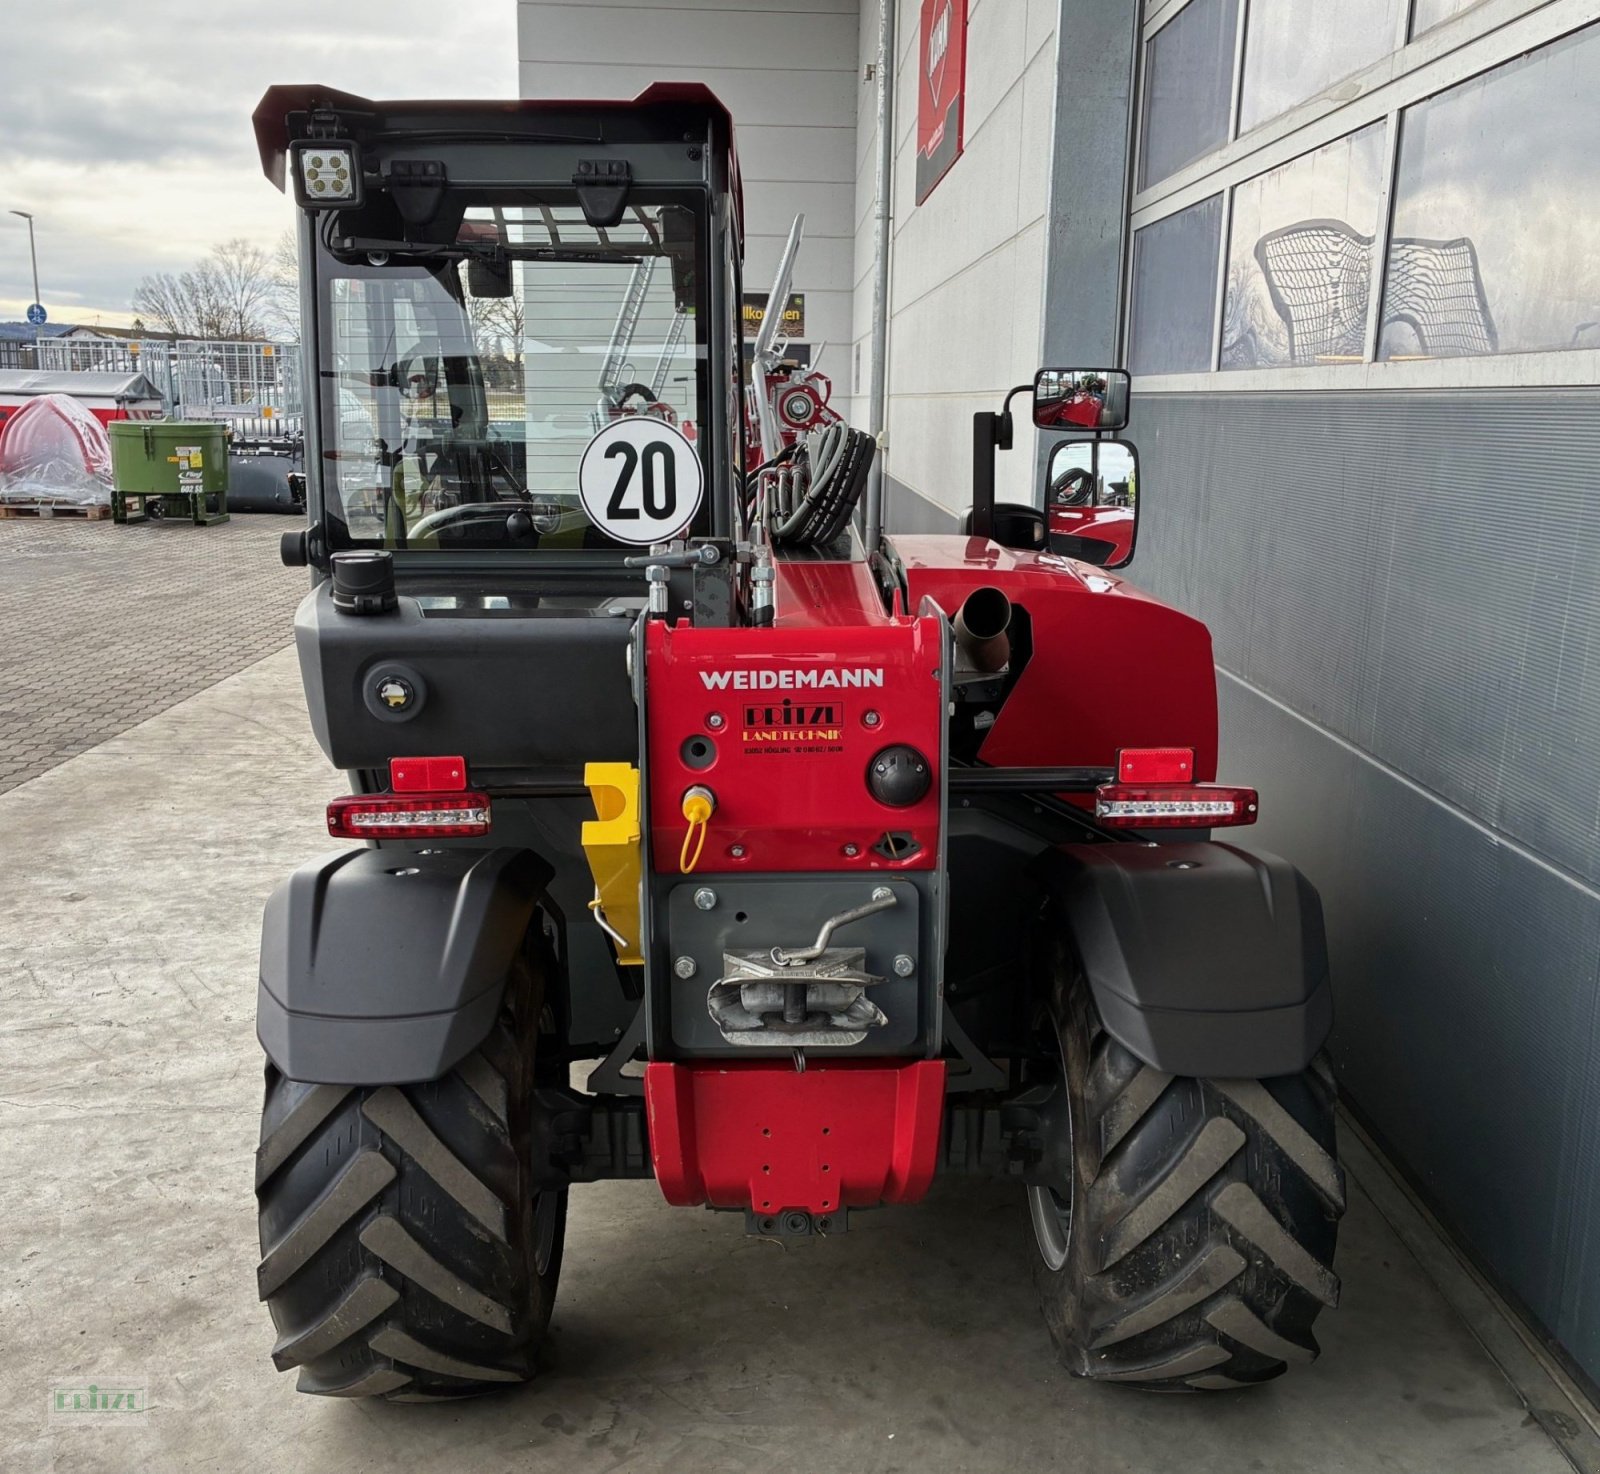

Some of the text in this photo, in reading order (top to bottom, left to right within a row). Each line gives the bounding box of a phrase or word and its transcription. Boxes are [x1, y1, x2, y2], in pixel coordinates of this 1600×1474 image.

[604, 441, 677, 520] 20
[699, 668, 884, 690] WEIDEMANN
[743, 729, 843, 741] LANDTECHNIK
